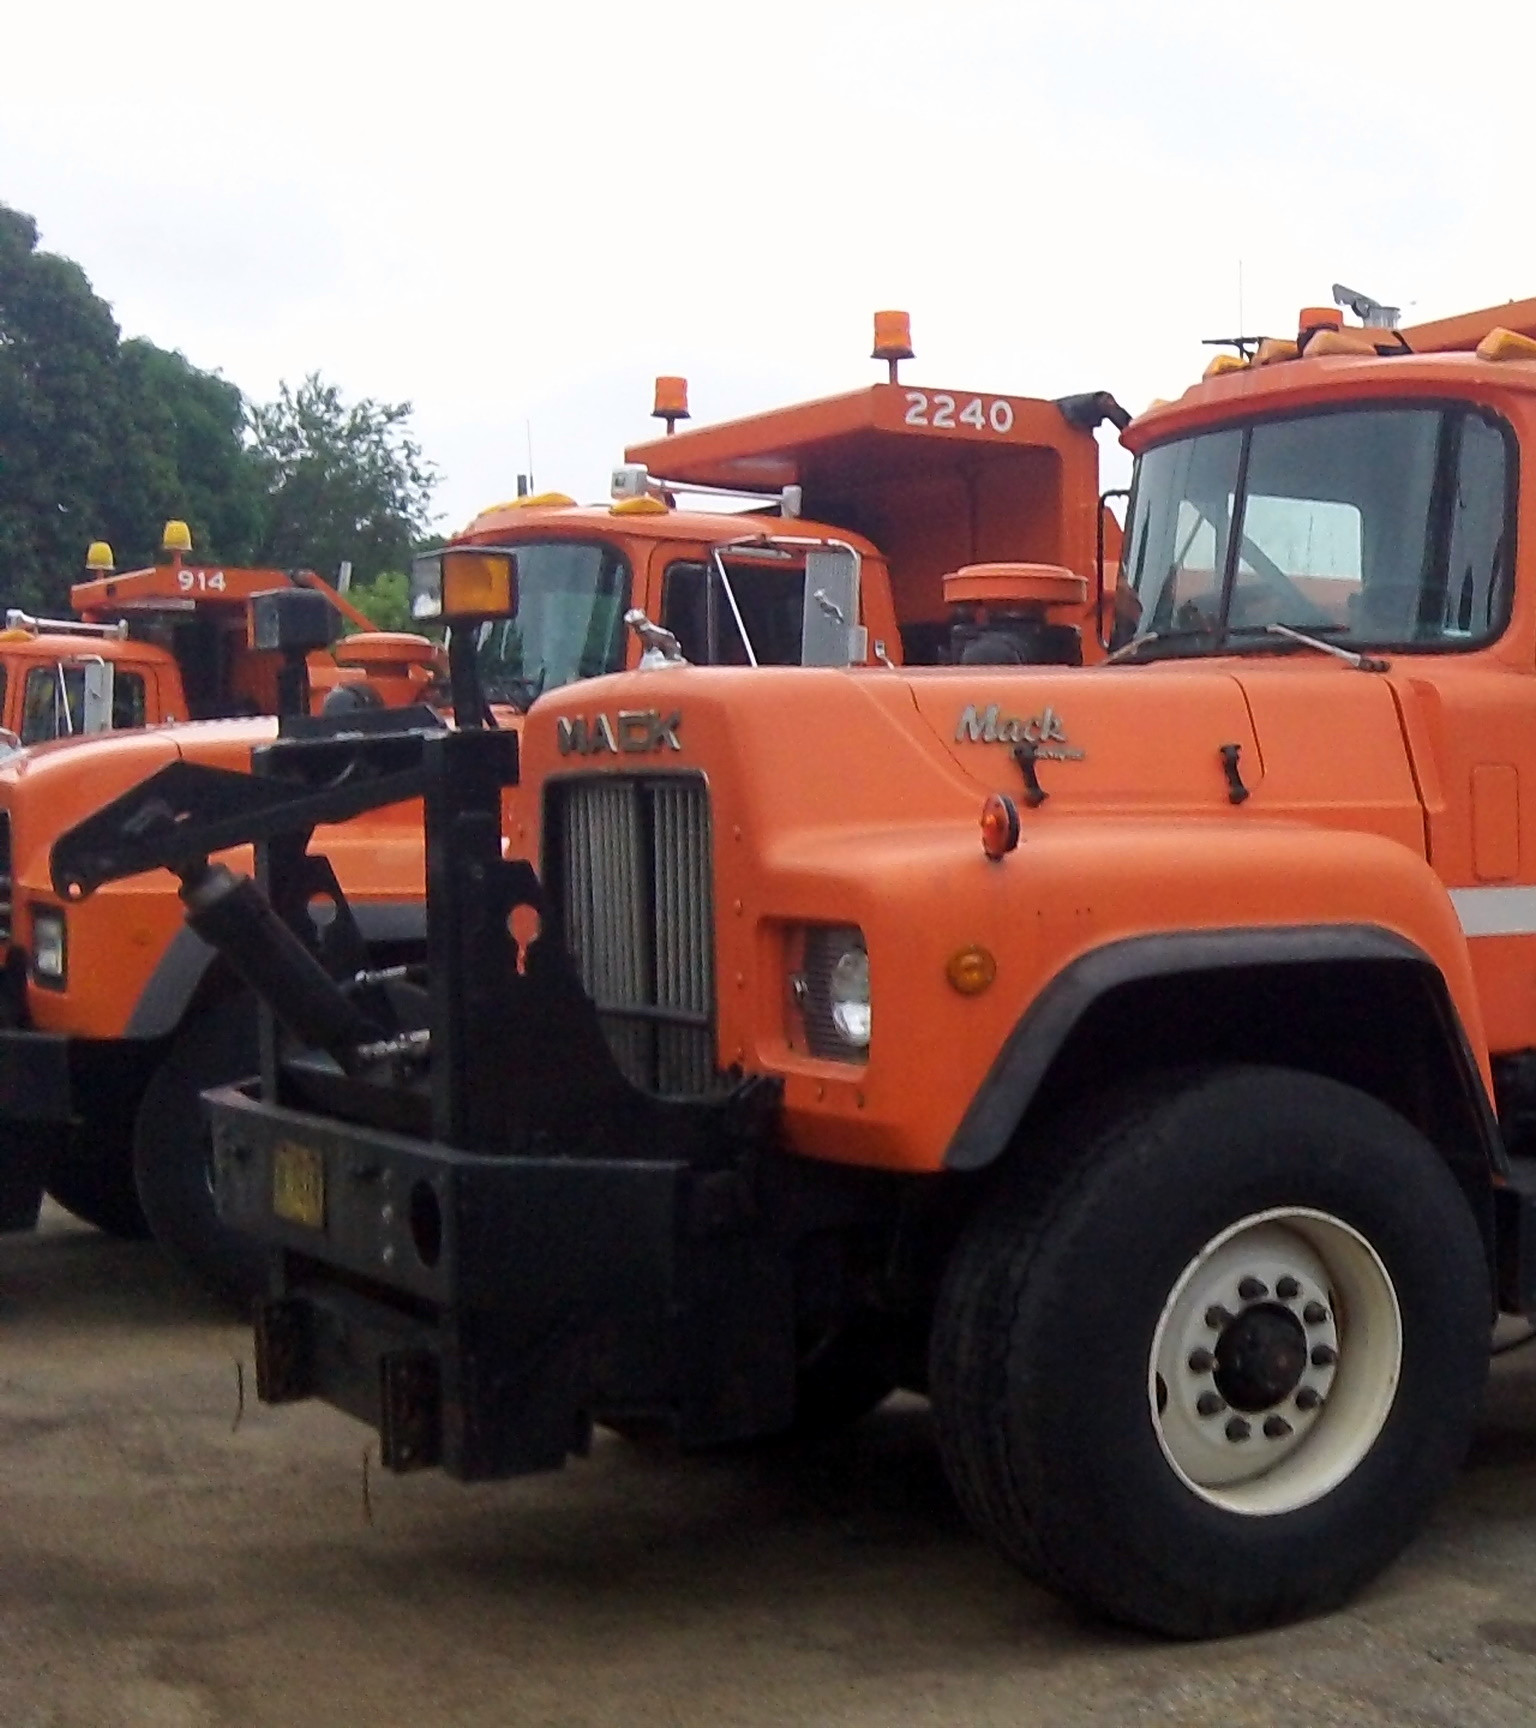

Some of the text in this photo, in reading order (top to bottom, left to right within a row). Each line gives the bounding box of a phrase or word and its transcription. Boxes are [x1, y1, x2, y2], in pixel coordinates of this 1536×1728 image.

[905, 391, 1014, 433] 2240
[178, 569, 226, 592] 914
[557, 709, 681, 756] MACK
[955, 704, 1065, 744] Mack
